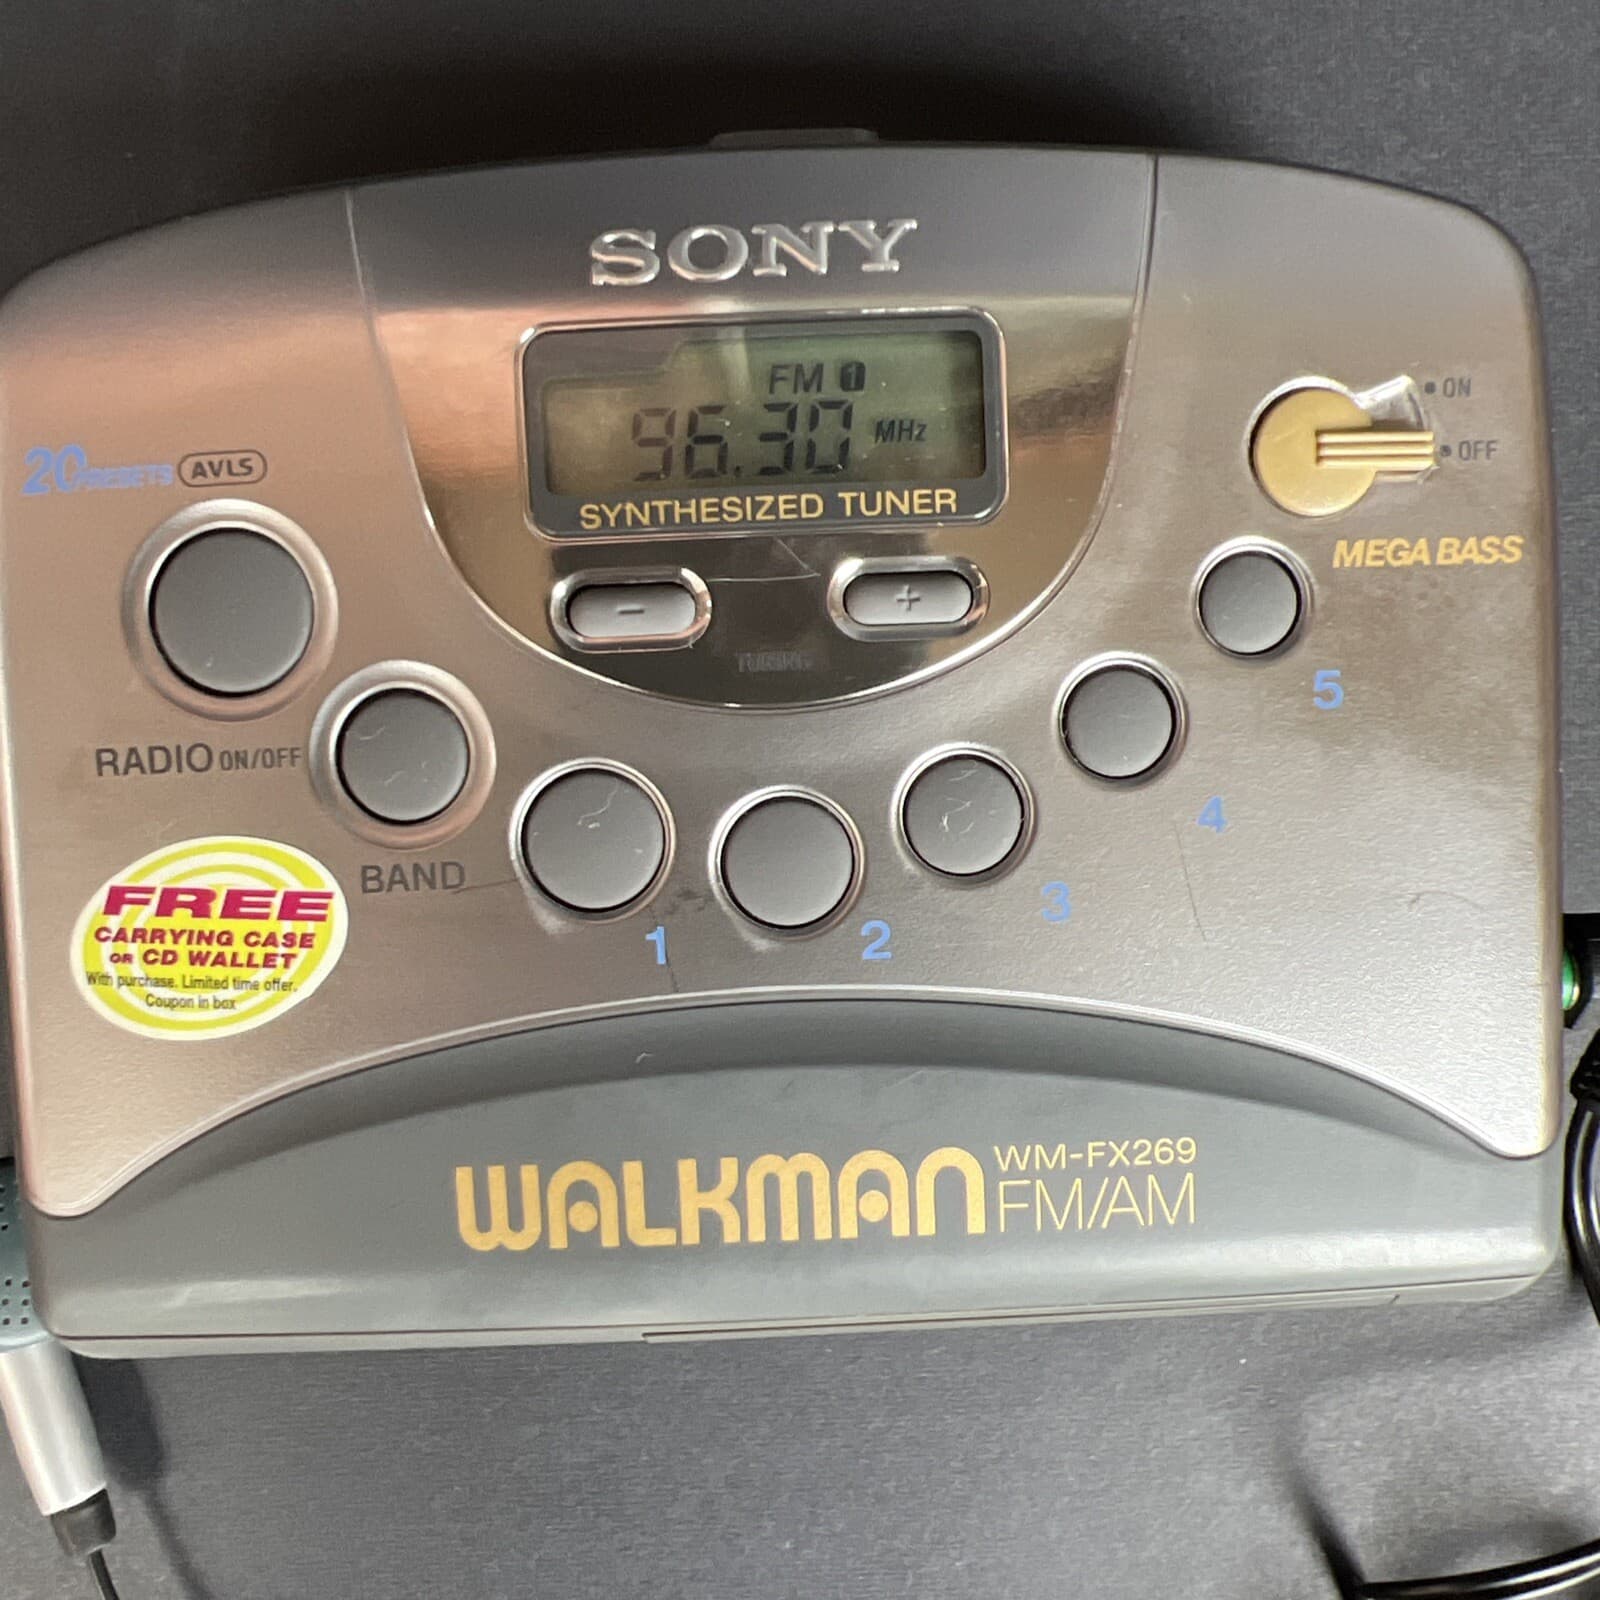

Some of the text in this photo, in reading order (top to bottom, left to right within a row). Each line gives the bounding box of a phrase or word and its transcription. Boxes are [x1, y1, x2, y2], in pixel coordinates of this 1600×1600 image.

[590, 217, 918, 286] SONY
[769, 363, 824, 395] FM
[1442, 377, 1472, 398] ON
[631, 401, 928, 482] 96.30 MHz
[1458, 440, 1498, 461] OFF
[21, 443, 87, 495] 20
[190, 457, 254, 480] AVLS
[579, 488, 959, 530] SYNTHESIZED TUNER
[1332, 535, 1525, 569] MEGA BASS
[1313, 669, 1345, 711] 5
[95, 743, 302, 777] RADIO ON/OFF
[1196, 796, 1228, 834] 4
[360, 861, 466, 895] BAND
[102, 884, 335, 923] FREE
[1040, 881, 1073, 923] 3
[93, 926, 316, 951] CARRYING CASE
[644, 926, 668, 966] 1
[860, 920, 893, 961] 2
[141, 949, 180, 967] CD
[187, 952, 298, 970] WALLET
[85, 972, 299, 993] With purchase. Limited time offer.
[145, 993, 236, 1010] Coupon in box
[993, 1137, 1198, 1171] WM-FX269
[454, 1145, 987, 1252] WALKMAN
[997, 1171, 1197, 1234] FM/AM
